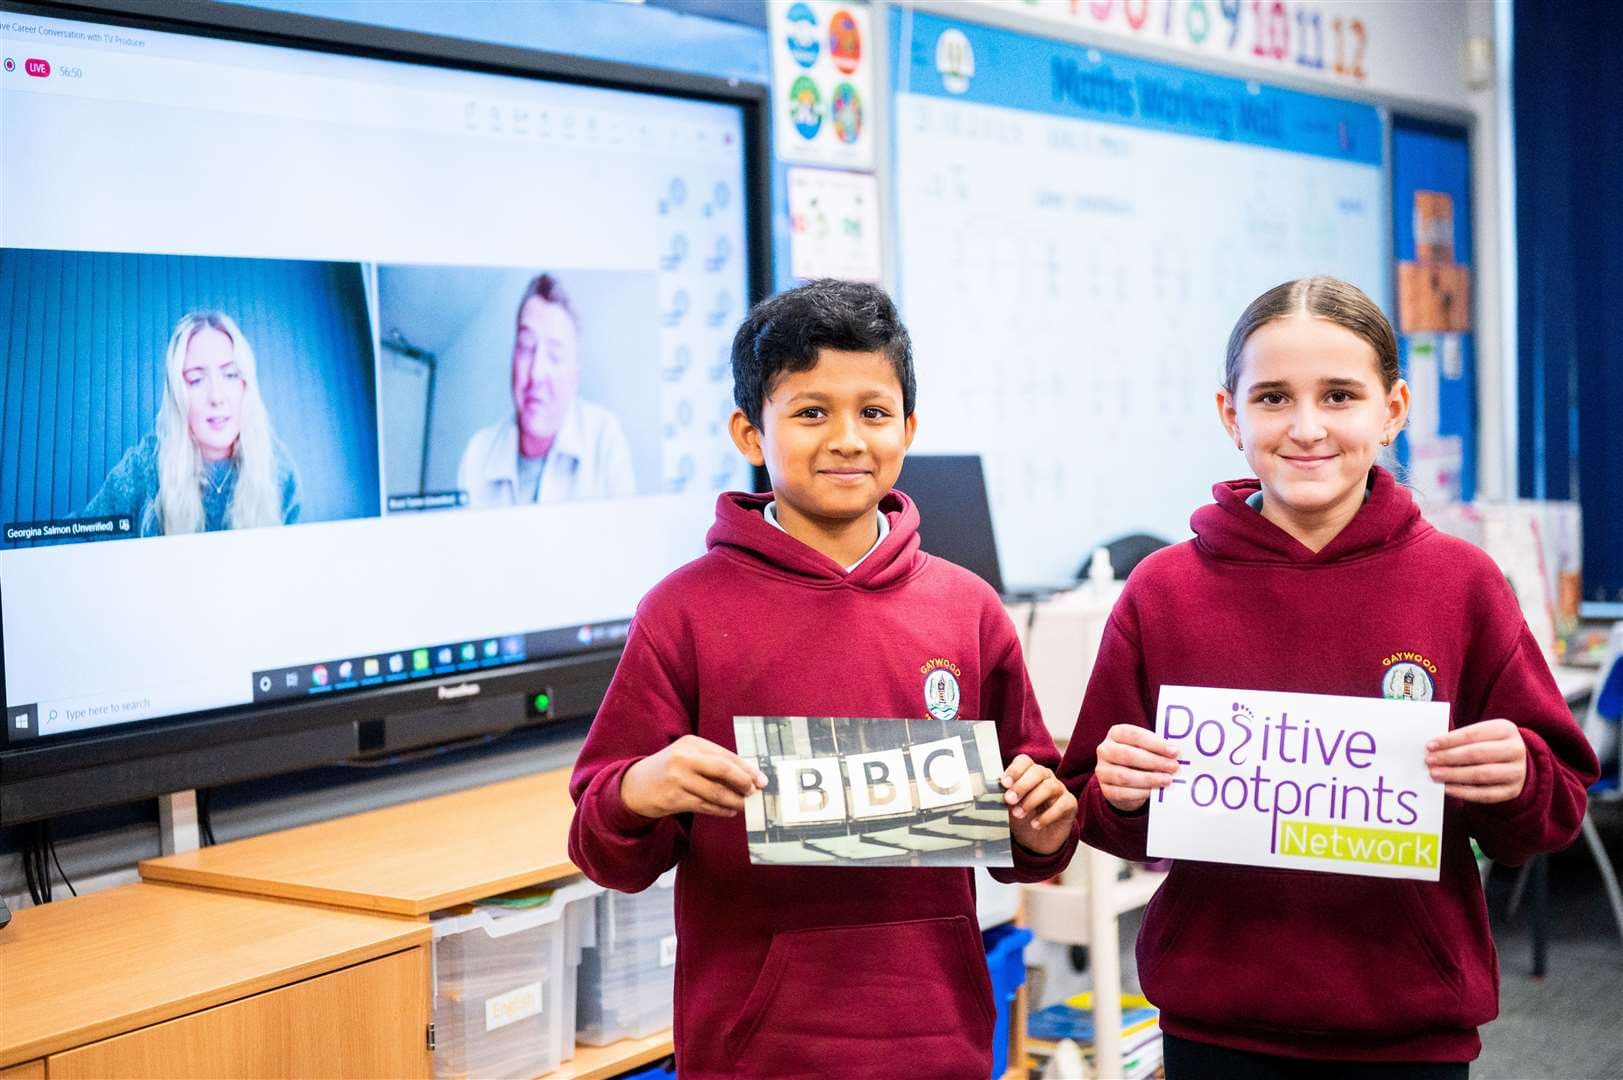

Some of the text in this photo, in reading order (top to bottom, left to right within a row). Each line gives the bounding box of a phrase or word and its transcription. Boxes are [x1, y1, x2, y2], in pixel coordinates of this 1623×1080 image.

[12, 22, 37, 34] Career
[38, 27, 86, 40] Conversation
[103, 35, 114, 43] TV
[1252, 0, 1290, 59] 10
[1296, 9, 1325, 69] 11
[1332, 17, 1367, 80] 12
[29, 63, 46, 73] LIVE
[7, 520, 114, 539] Georgina Salmon (Unverified)
[920, 657, 961, 677] GAYWOOD
[1382, 651, 1437, 673] GAYWOOD
[66, 697, 150, 721] Type here to search
[1163, 701, 1377, 769] Positive
[1283, 822, 1434, 866] Network
